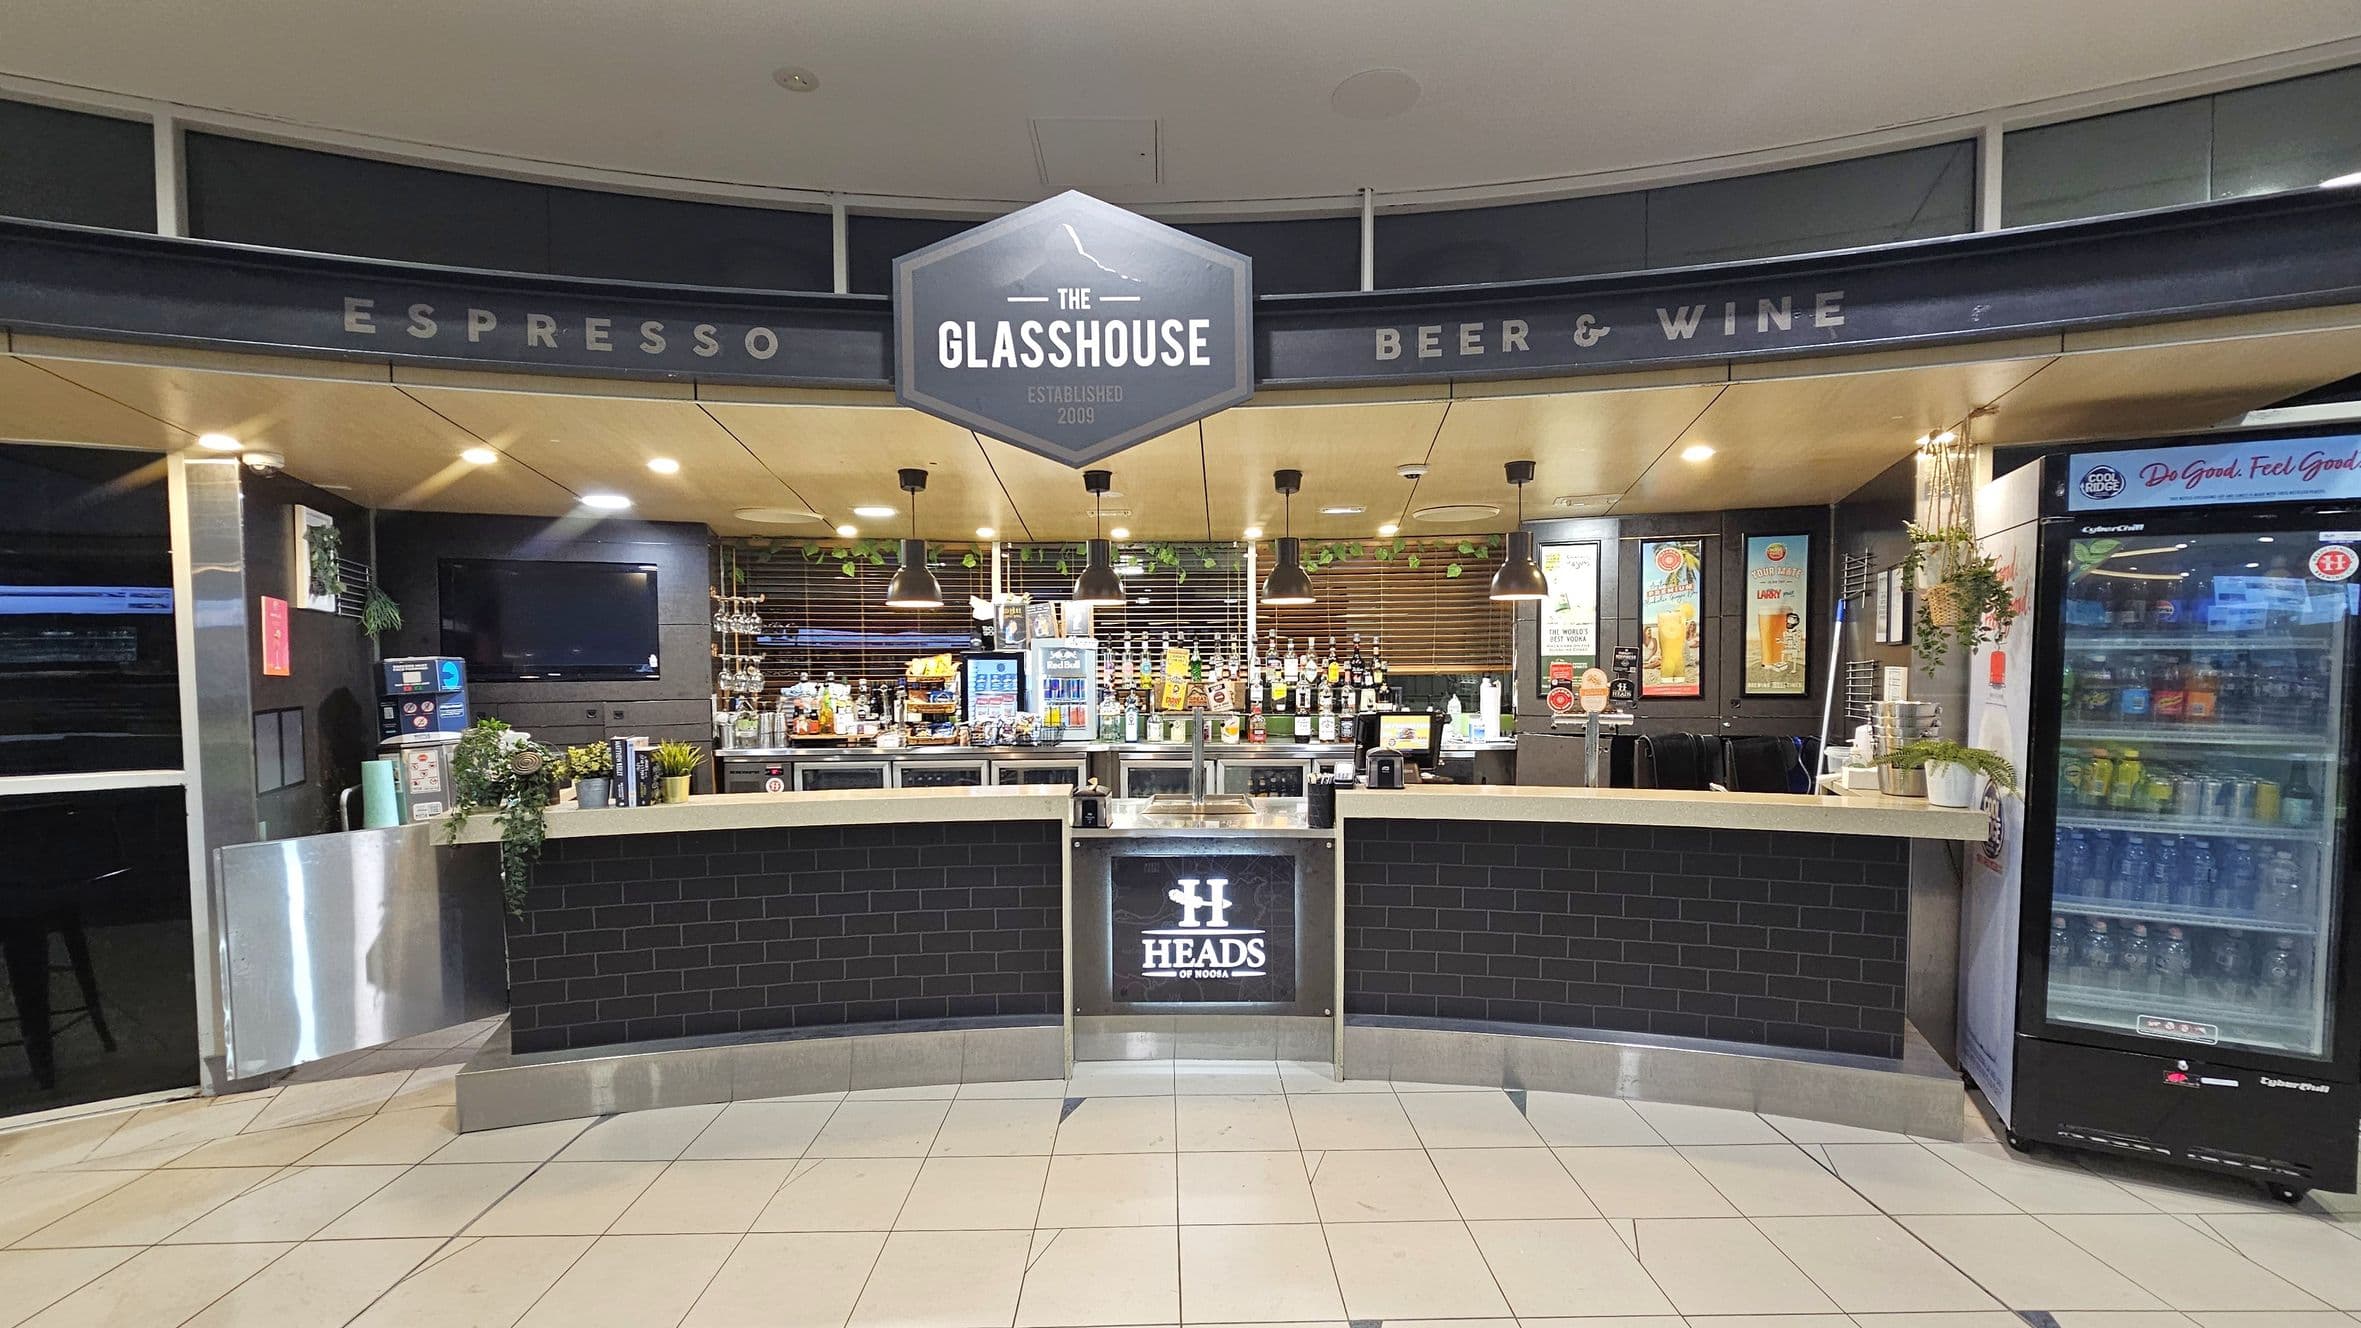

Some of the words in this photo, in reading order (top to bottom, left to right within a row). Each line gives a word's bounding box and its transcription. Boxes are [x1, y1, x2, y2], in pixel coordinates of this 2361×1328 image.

[1057, 287, 1092, 310] THE
[343, 296, 780, 361] ESPRESSO
[1375, 319, 1530, 361] BEER
[1573, 313, 1611, 348] &
[1656, 290, 1846, 341] WINE
[937, 318, 1211, 370] GLASSHOUSE
[1027, 385, 1124, 405] ESTABLISHED
[1057, 407, 1096, 425] 2009
[2088, 472, 2118, 483] COOL
[2139, 462, 2178, 488] Do
[2181, 458, 2242, 490] Good.
[2250, 455, 2296, 480] Feel
[2085, 481, 2120, 493] RIDGE
[1751, 566, 1775, 579] YOUR
[1647, 583, 1693, 598] PREMIUM
[1756, 588, 1782, 600] LARRY
[1549, 635, 1564, 643] BEST
[1566, 635, 1587, 643] VODKA
[1562, 627, 1589, 635] WORLD'S
[1046, 660, 1063, 669] Red
[1064, 660, 1081, 669] Bull
[1176, 878, 1230, 928] H
[1141, 938, 1266, 969] HEADS
[1179, 970, 1194, 978] OF
[1194, 970, 1229, 979] NOOSA
